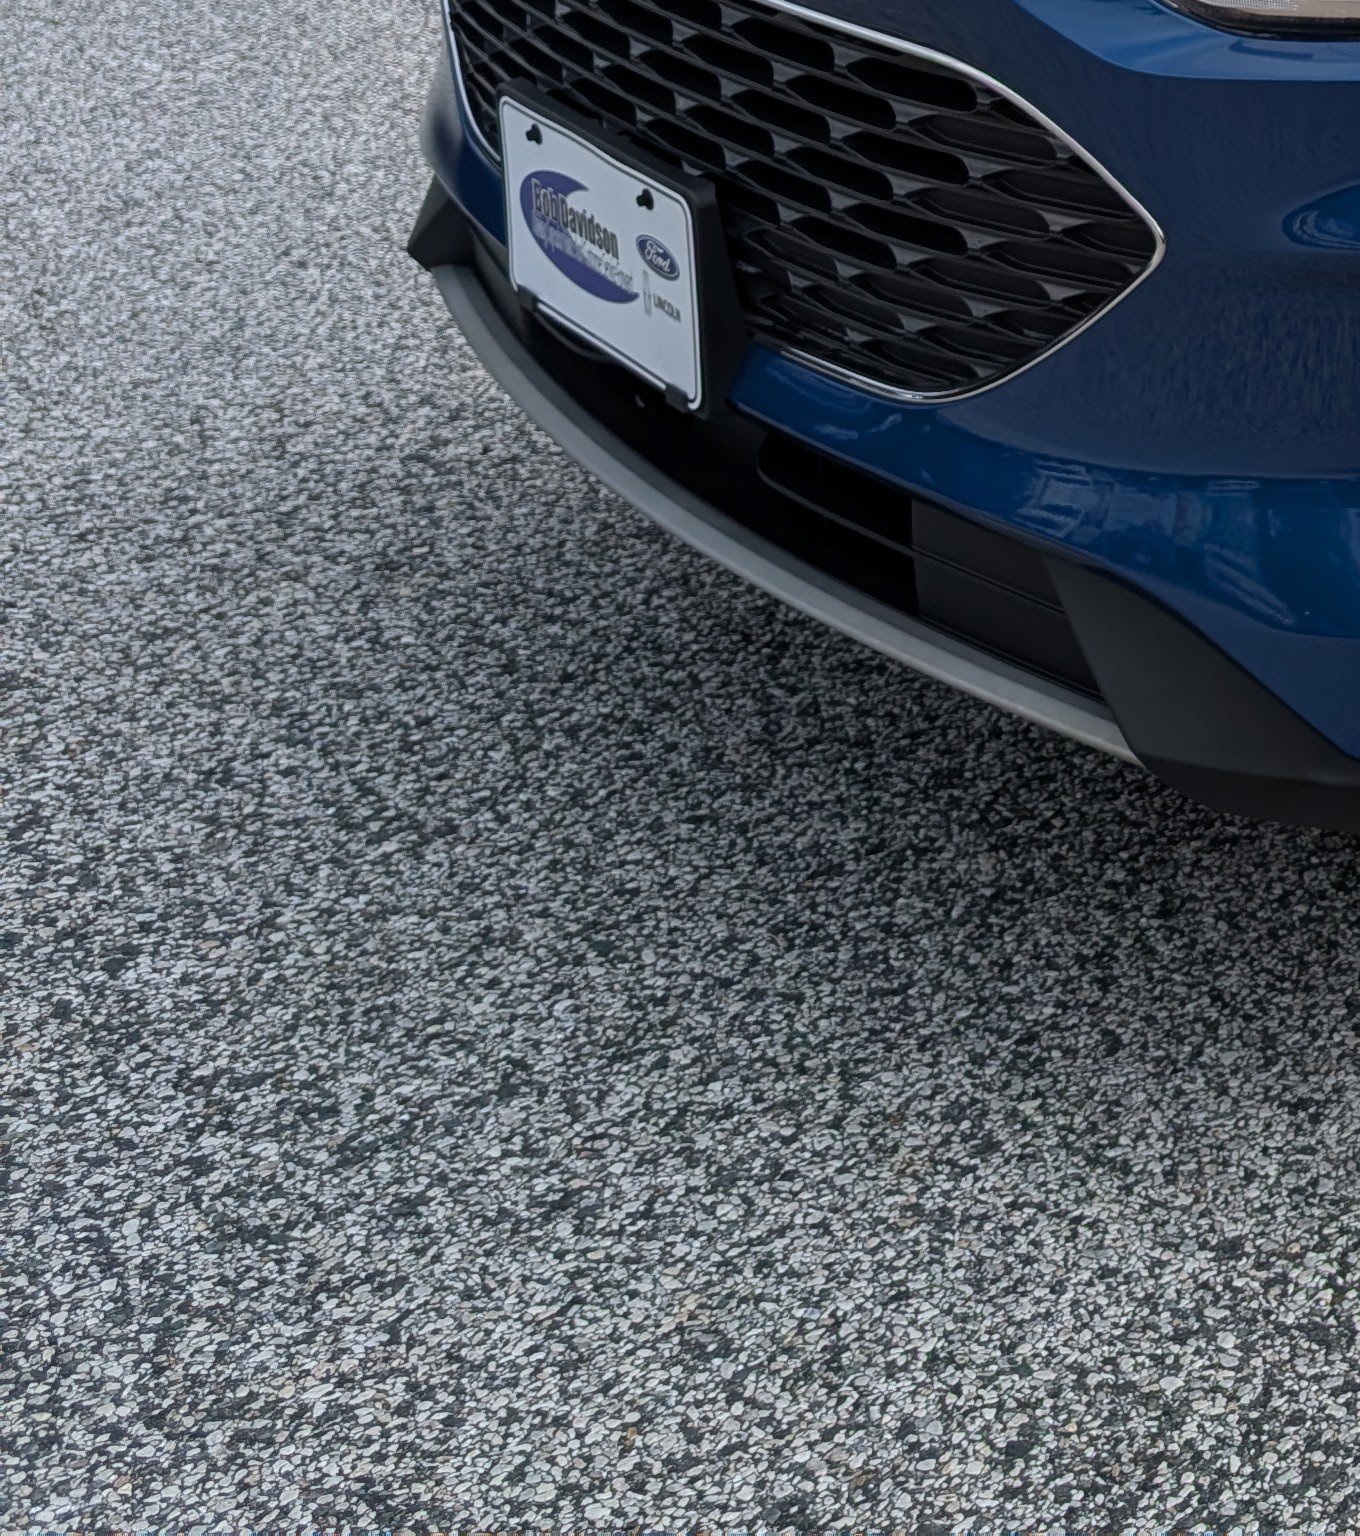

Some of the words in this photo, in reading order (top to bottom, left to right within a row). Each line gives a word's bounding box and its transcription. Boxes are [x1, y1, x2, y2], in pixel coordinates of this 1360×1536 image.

[531, 177, 559, 221] Bob
[557, 191, 620, 260] Davidson
[645, 239, 671, 272] Ford
